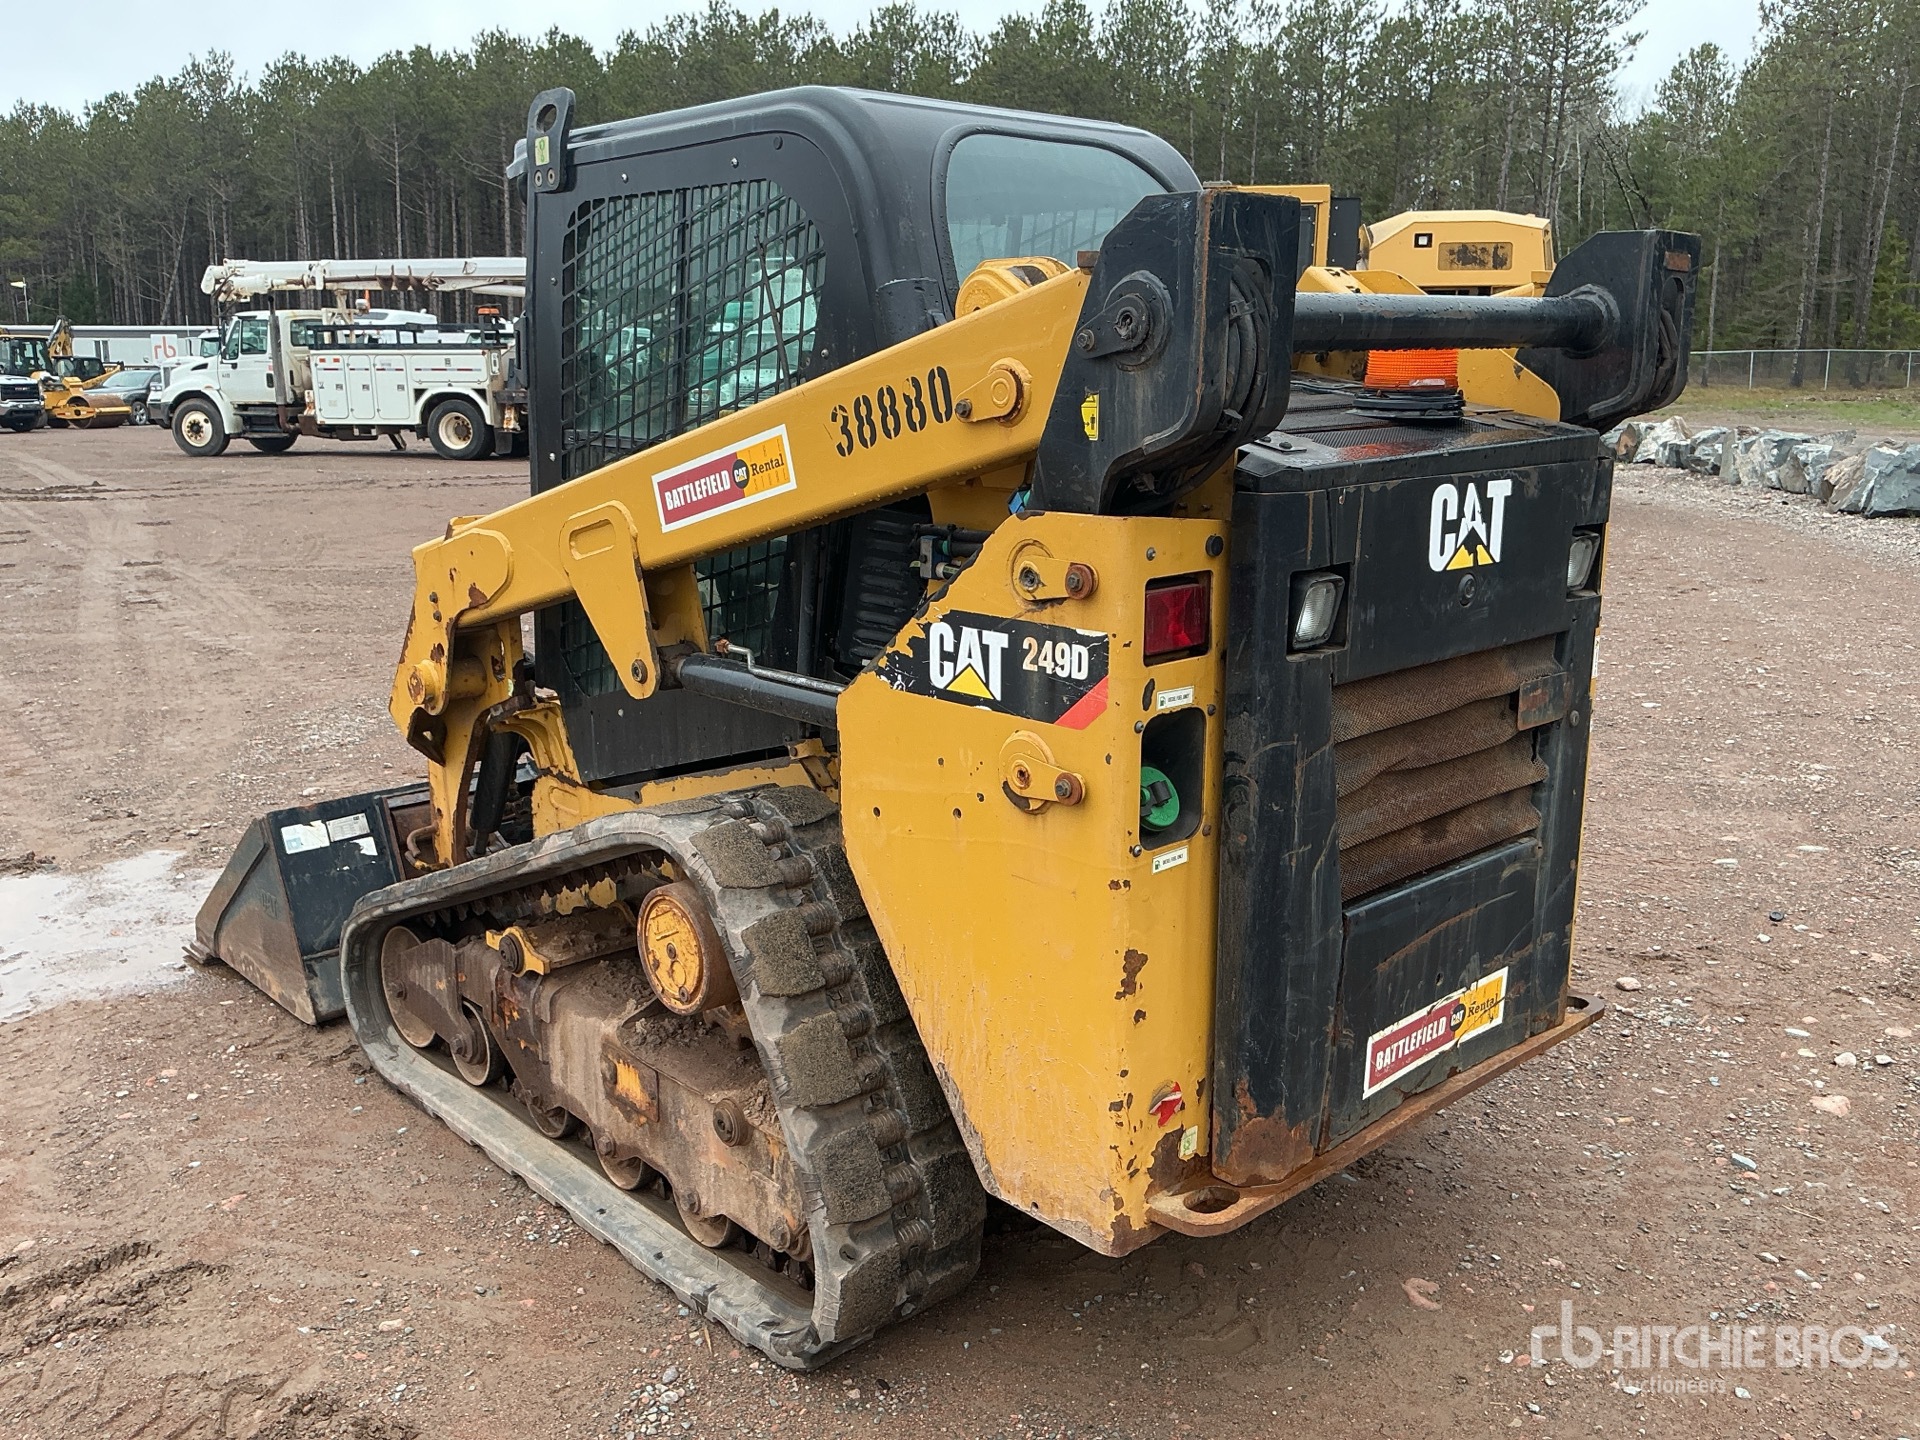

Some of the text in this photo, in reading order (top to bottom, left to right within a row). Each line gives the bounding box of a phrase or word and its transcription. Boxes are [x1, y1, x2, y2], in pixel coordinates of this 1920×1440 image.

[831, 365, 953, 457] 38880
[664, 453, 785, 511] BATTLEFIELD CAT Rental
[1428, 479, 1512, 572] CAT
[929, 622, 1089, 701] CAT 249D
[1375, 1016, 1447, 1071] BATTLEFIELD
[1450, 1009, 1465, 1027] CAT
[1467, 993, 1499, 1018] Rental
